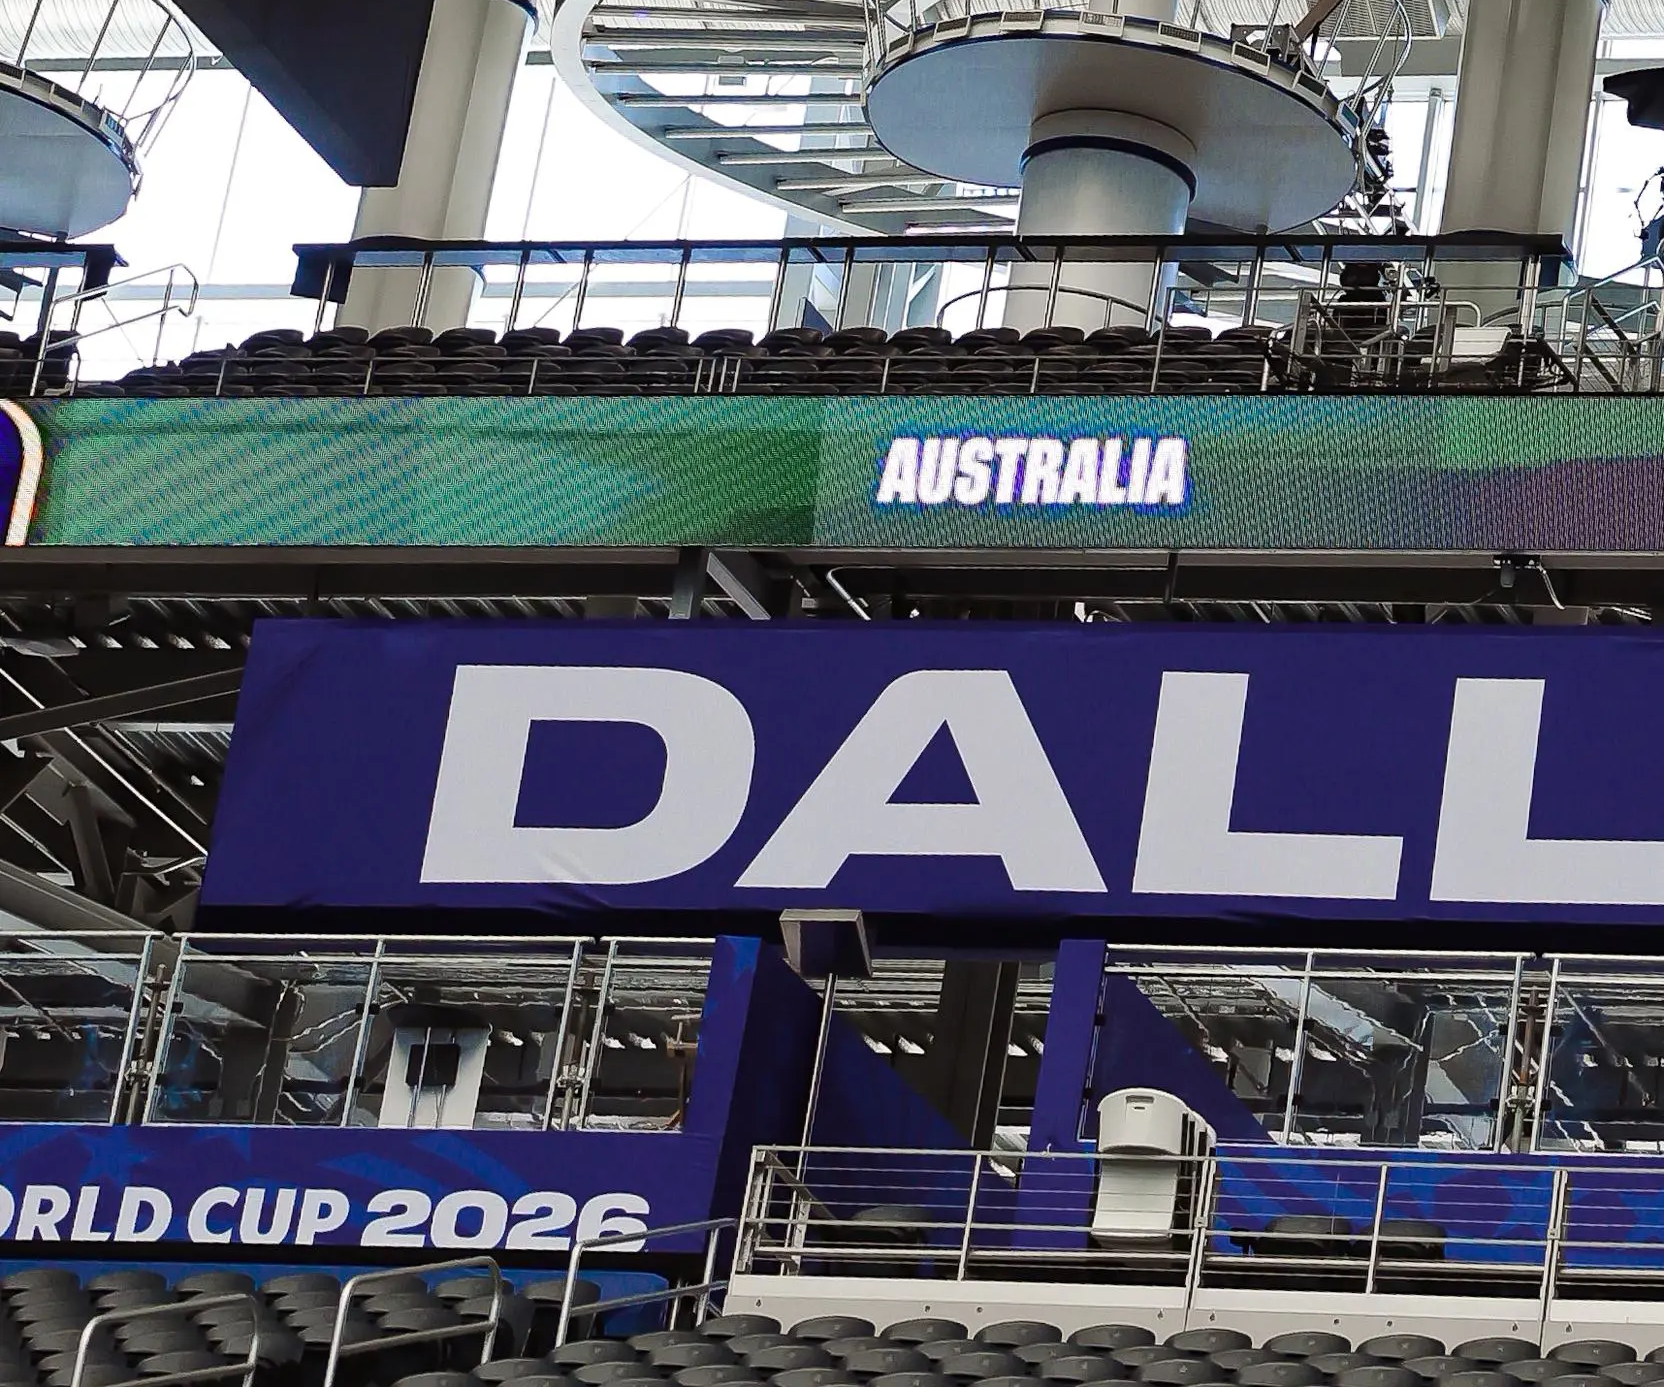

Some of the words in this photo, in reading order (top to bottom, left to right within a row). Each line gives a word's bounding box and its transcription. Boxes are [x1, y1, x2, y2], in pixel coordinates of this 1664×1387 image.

[876, 434, 1188, 505] AUSTRALIA
[0, 1184, 173, 1242] RLD
[187, 1186, 350, 1246] CUP
[360, 1189, 649, 1253] 2026
